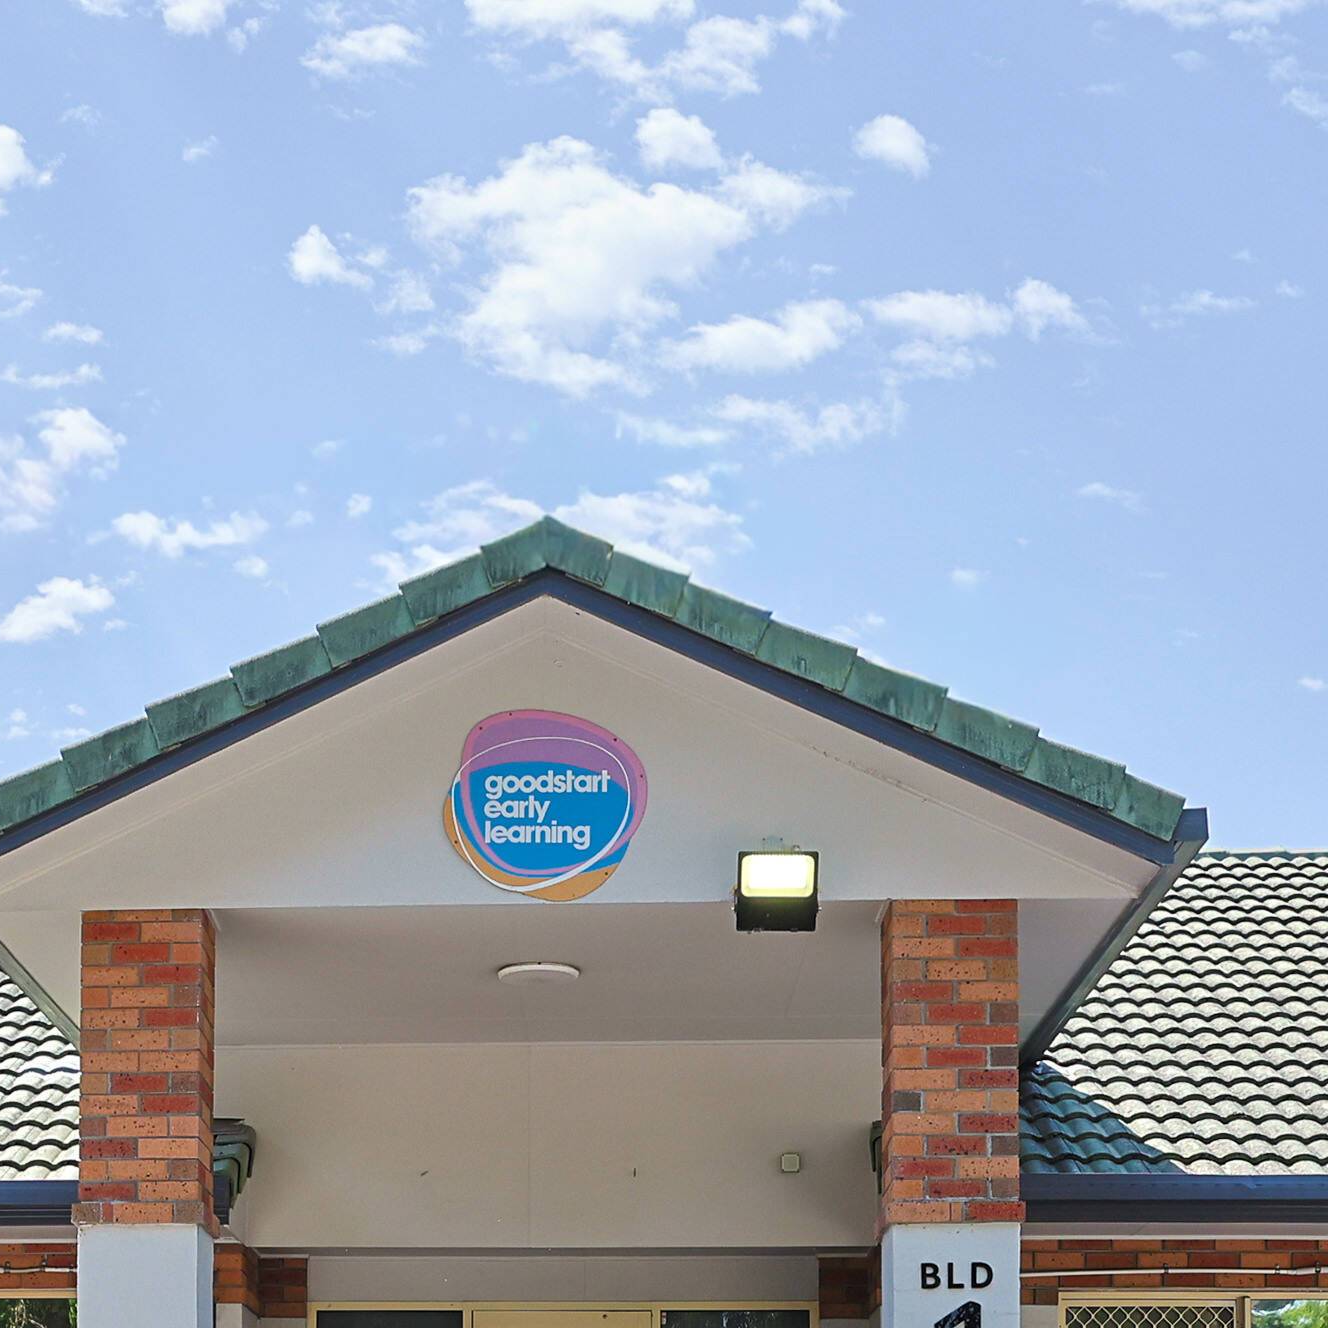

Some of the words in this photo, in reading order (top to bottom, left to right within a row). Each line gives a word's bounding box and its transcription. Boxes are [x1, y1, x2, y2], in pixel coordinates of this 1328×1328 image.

[484, 769, 611, 800] goodstart
[483, 796, 551, 823] early
[484, 820, 591, 850] learning
[920, 1262, 994, 1290] BLD
